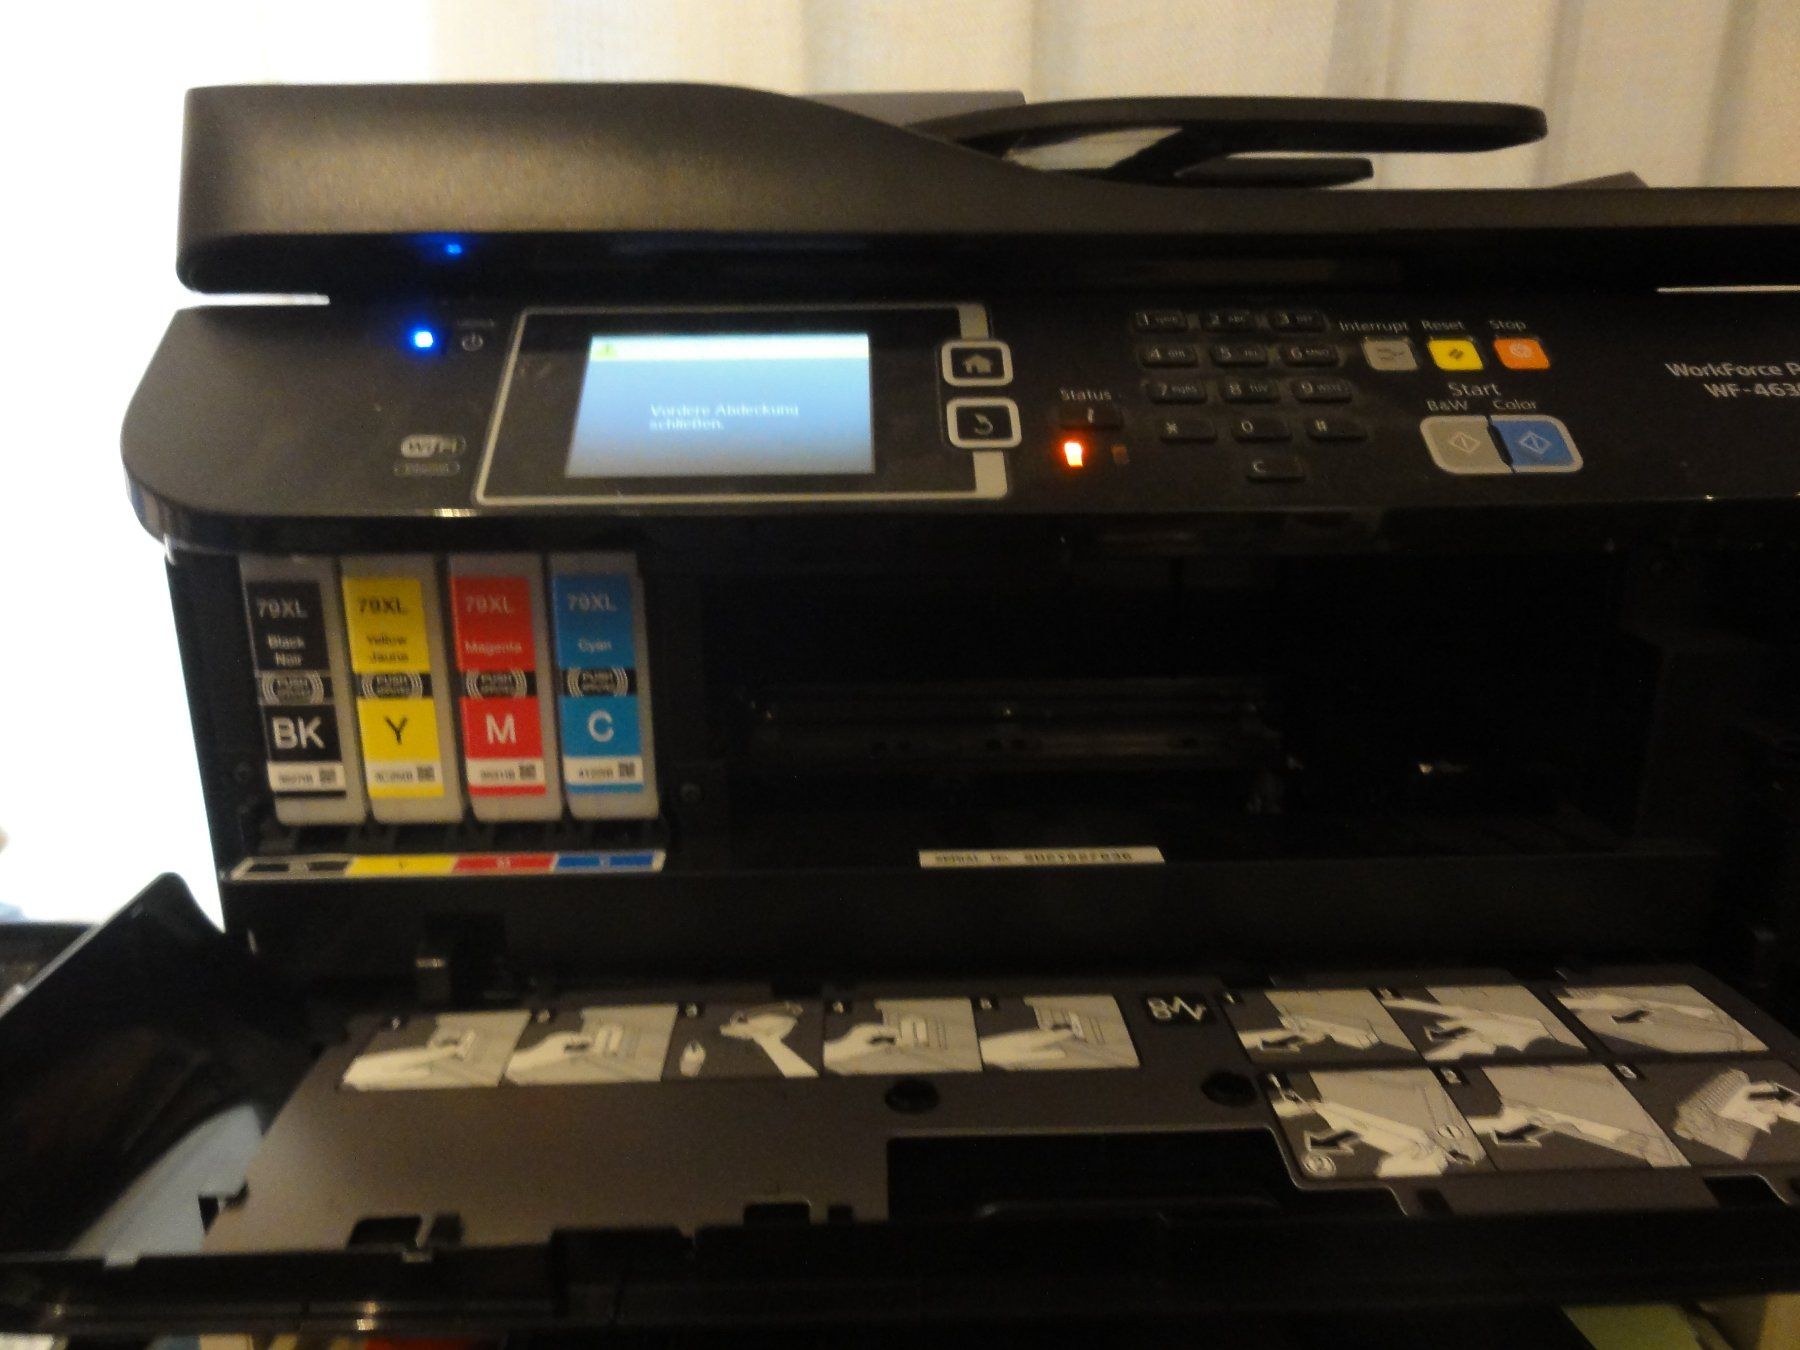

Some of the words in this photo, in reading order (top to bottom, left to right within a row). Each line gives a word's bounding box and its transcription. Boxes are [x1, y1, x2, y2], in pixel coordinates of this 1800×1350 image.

[1339, 321, 1410, 334] Interrupt
[1420, 320, 1465, 331] Reset
[1488, 320, 1527, 331] Stop
[1664, 361, 1784, 377] WorkForce
[1058, 388, 1112, 401] Status
[1447, 382, 1503, 398] Start
[649, 403, 710, 417] Vordere
[1492, 399, 1538, 411] Color
[256, 597, 309, 618] 79XL
[359, 596, 410, 614] 79XL
[465, 593, 515, 615] 79XL
[566, 592, 618, 612] 79XL
[464, 640, 523, 656] Magenta
[577, 639, 613, 654] Cyan
[272, 716, 325, 749] BK
[385, 716, 407, 745] Y
[485, 713, 517, 744] M
[587, 709, 615, 743] C
